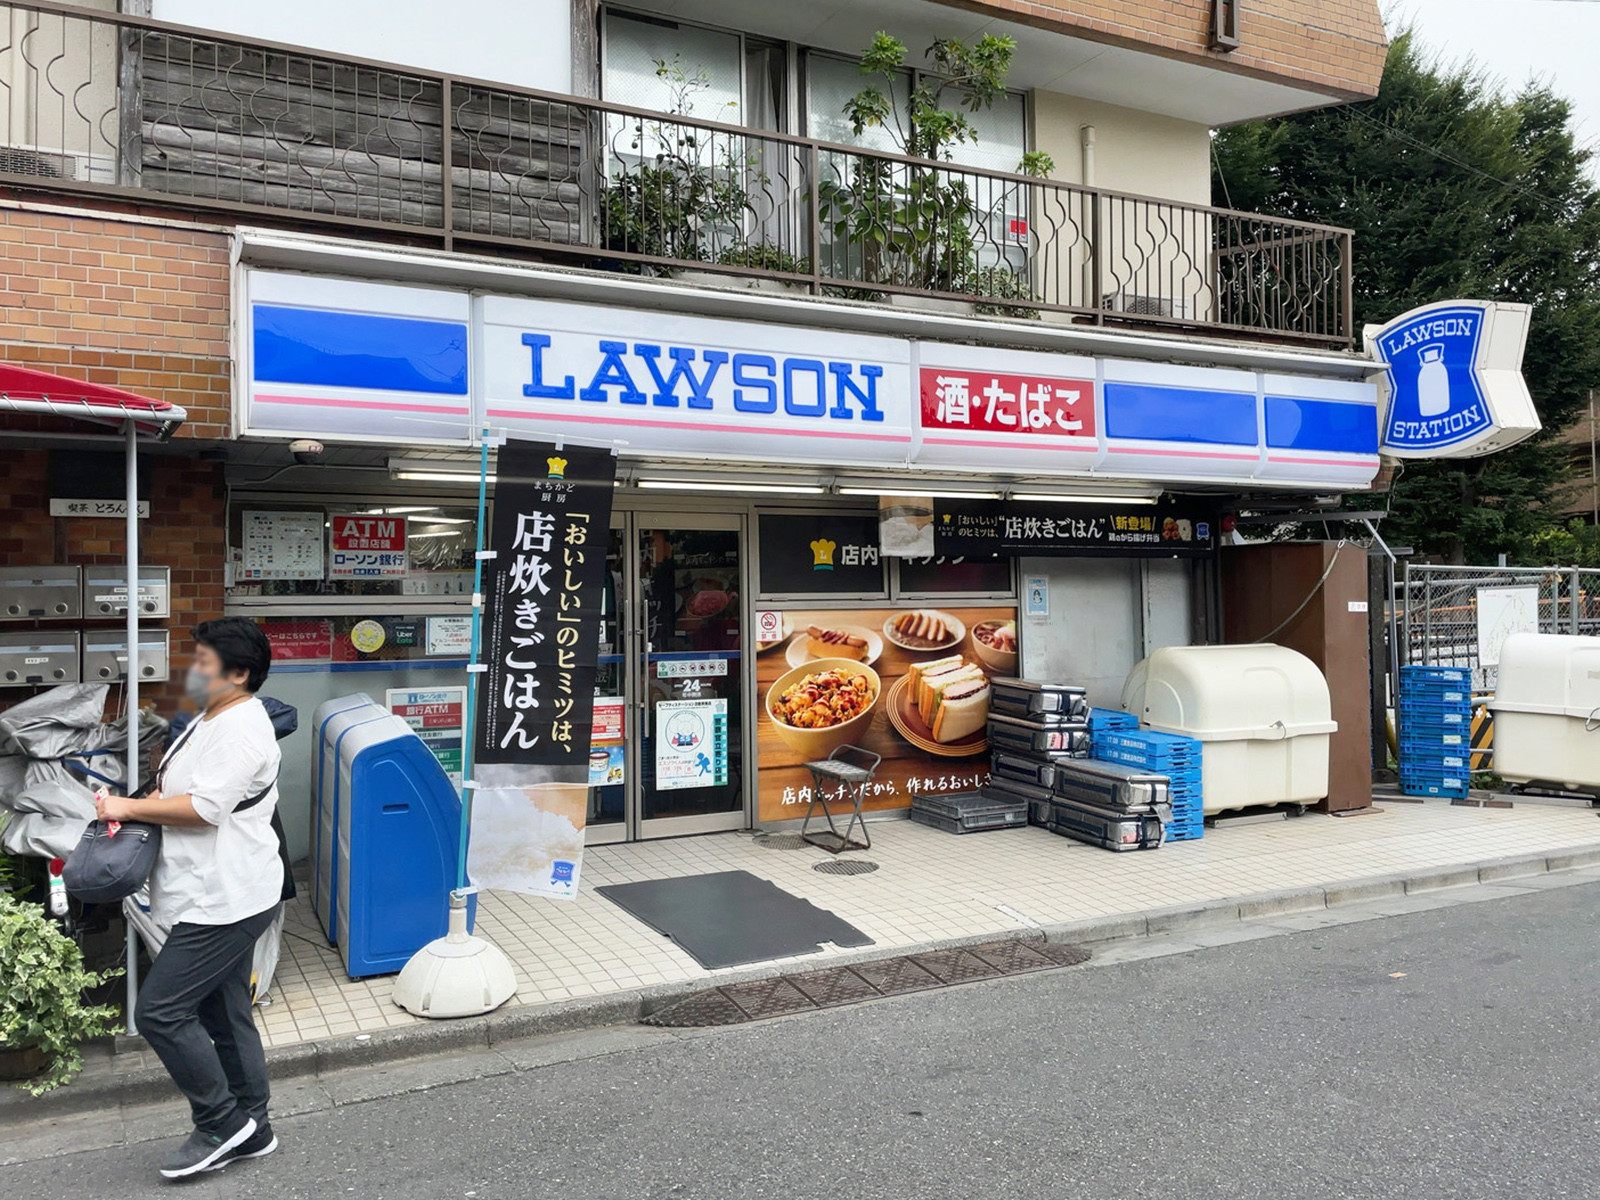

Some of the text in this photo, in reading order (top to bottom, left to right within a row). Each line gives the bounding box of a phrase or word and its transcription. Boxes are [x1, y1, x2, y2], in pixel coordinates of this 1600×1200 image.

[1389, 319, 1473, 355] LAWSON
[521, 333, 884, 421] LAWSON
[1393, 404, 1481, 439] STATION
[534, 481, 575, 493] まちかど
[342, 520, 396, 538] ATM
[334, 553, 405, 566] ローソン銀行
[500, 510, 556, 749] 店炊きごはん
[682, 679, 701, 692] 24
